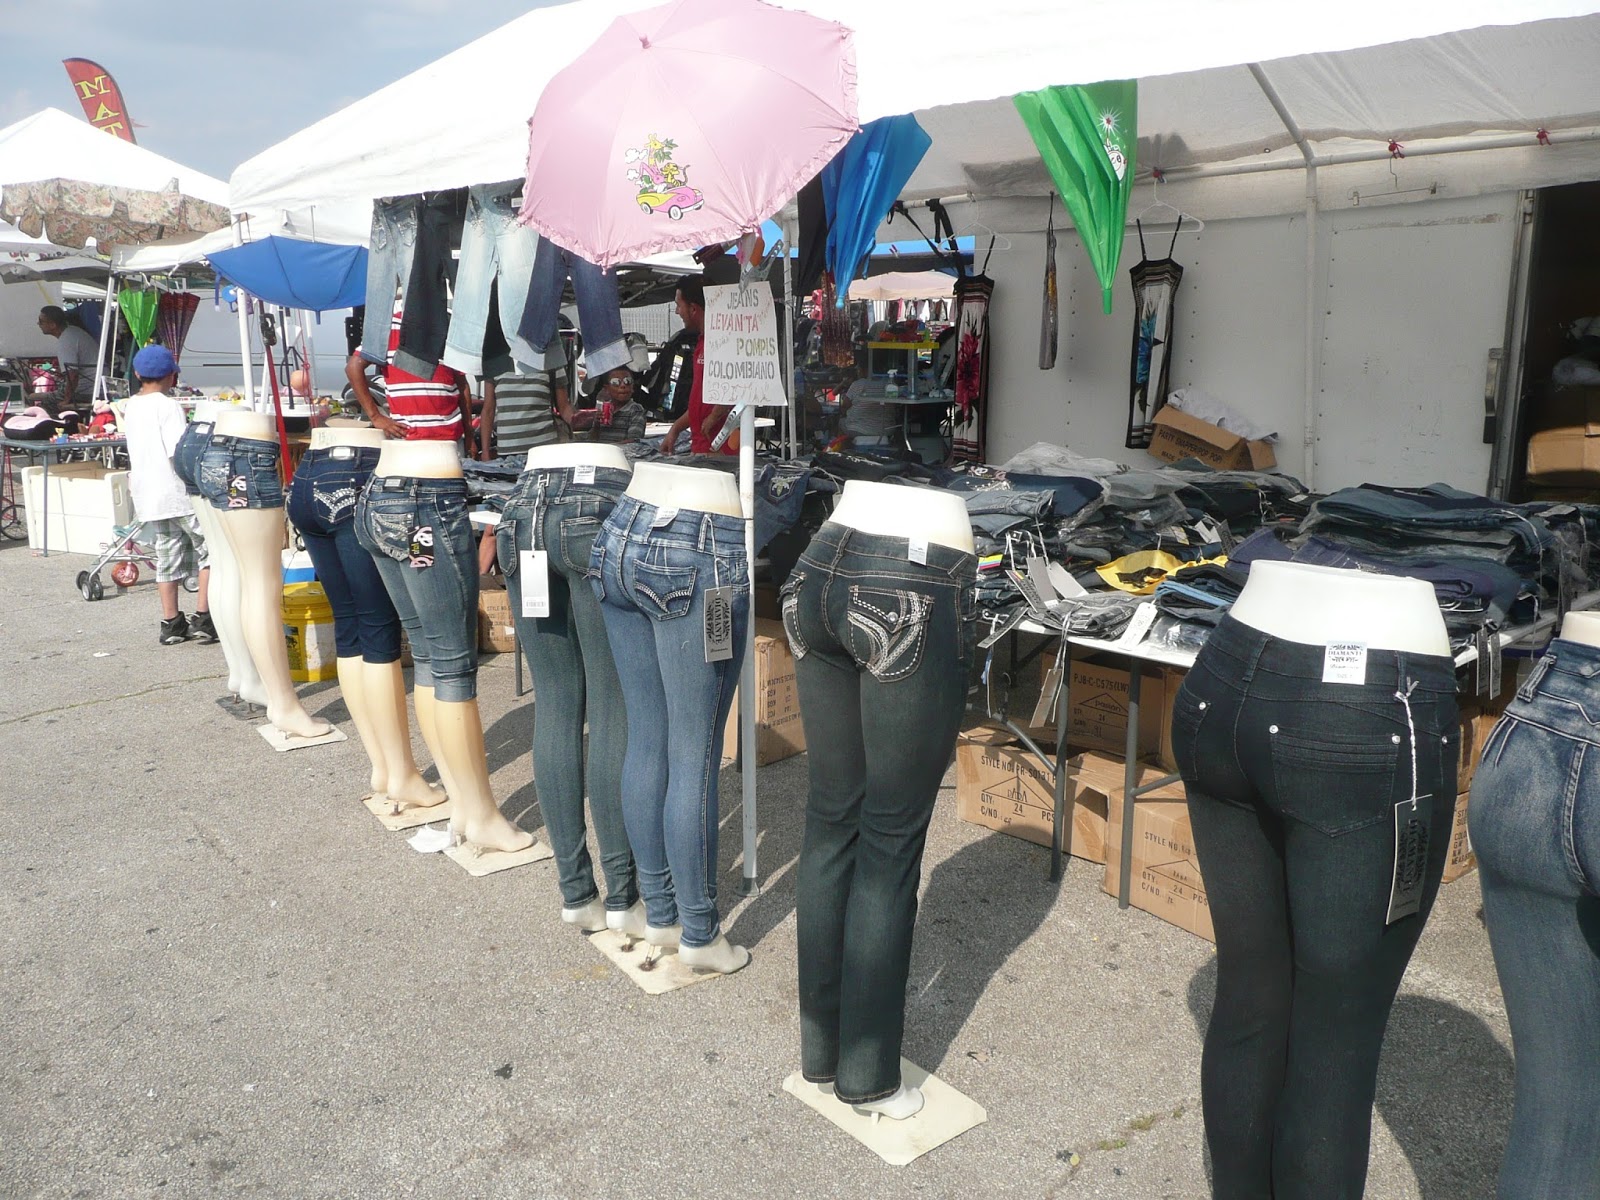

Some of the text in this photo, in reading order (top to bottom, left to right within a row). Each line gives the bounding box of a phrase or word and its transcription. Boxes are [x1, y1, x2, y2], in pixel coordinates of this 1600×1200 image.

[727, 288, 759, 310] JEANS
[710, 313, 759, 333] LEVANTA
[736, 337, 776, 357] POMPIS
[708, 360, 775, 380] COLOMBIANO
[981, 755, 1000, 769] STYLE
[1014, 803, 1023, 813] 24
[1041, 811, 1055, 822] PCS
[1145, 831, 1166, 846] STYLE
[1173, 884, 1183, 894] 24
[1192, 893, 1208, 906] PCS
